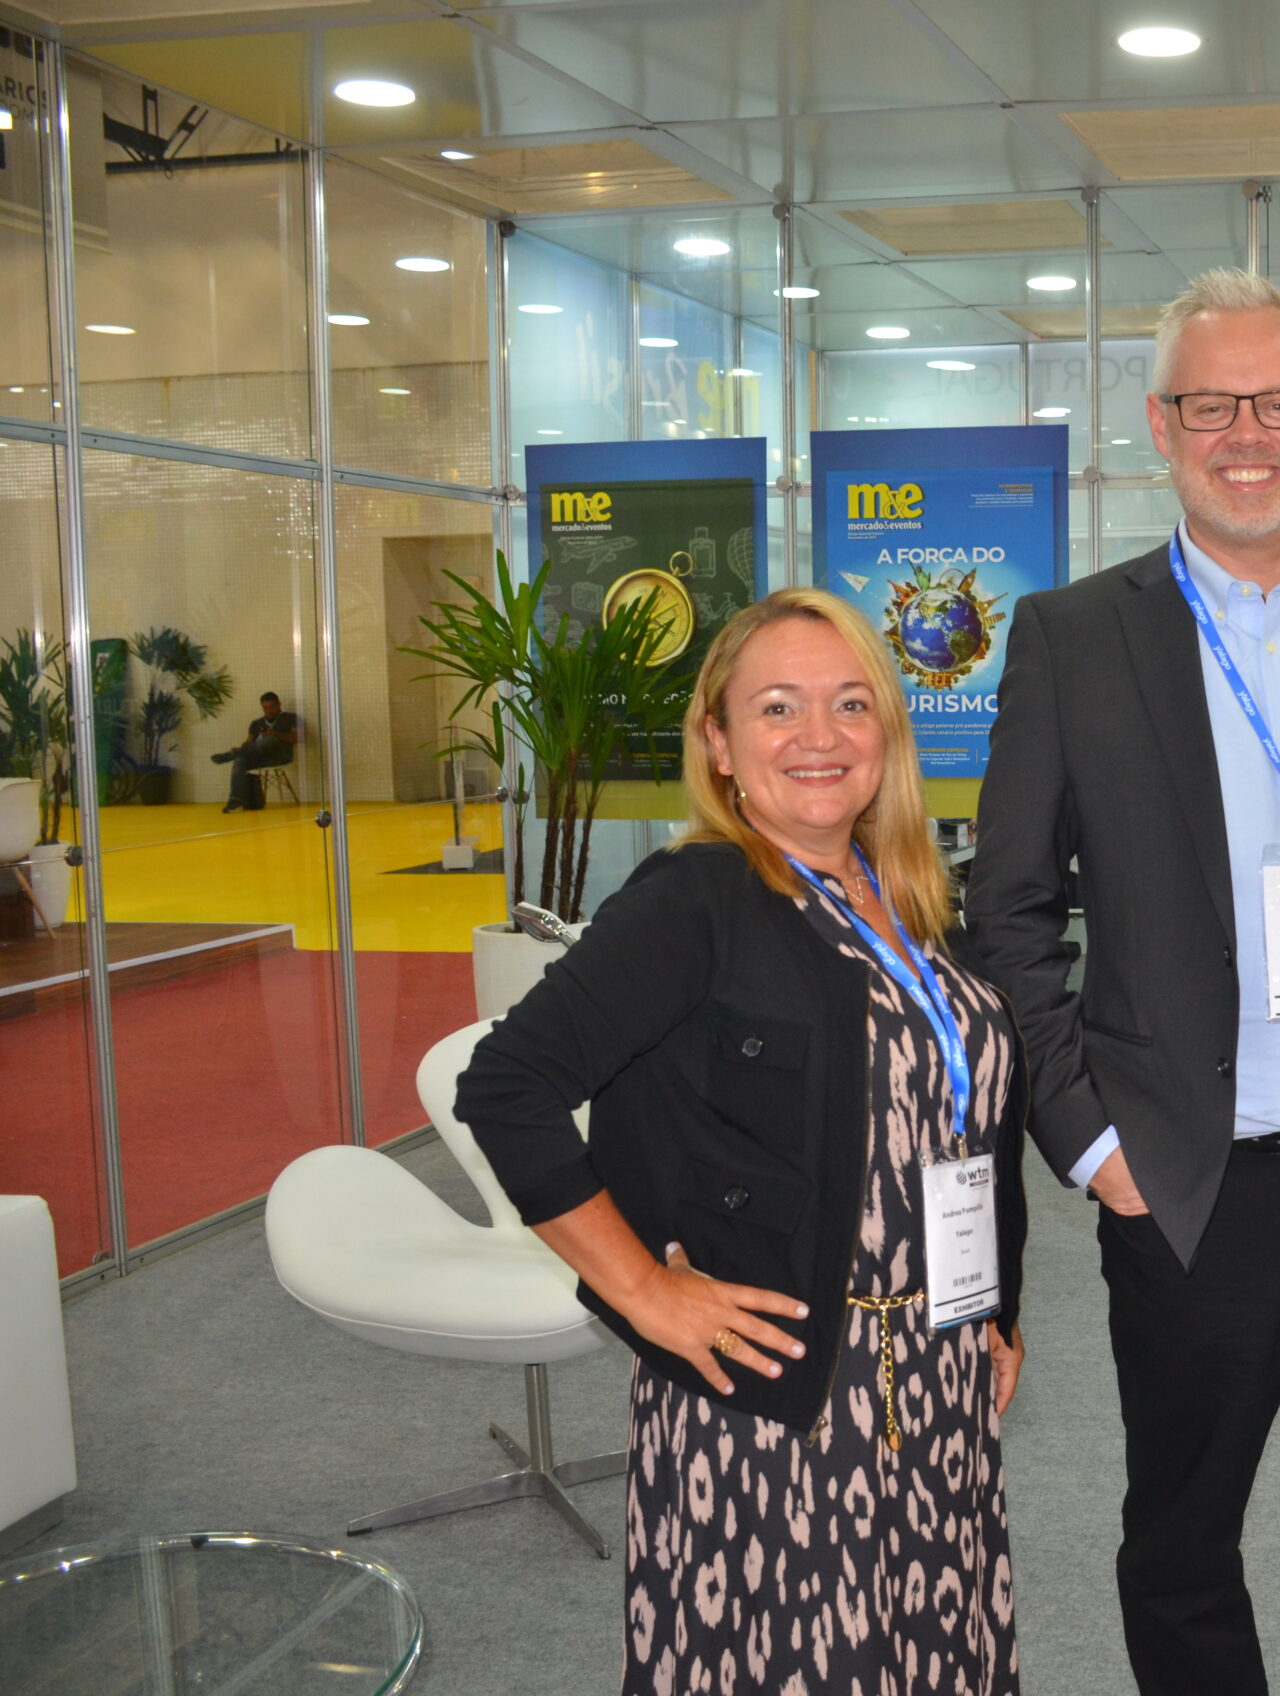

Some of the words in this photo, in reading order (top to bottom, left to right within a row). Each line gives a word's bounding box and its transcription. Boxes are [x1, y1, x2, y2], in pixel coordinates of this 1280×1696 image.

[550, 491, 613, 523] m&e
[847, 483, 925, 520] m&e
[551, 523, 613, 532] mercado&eventos
[847, 521, 922, 531] mercado&eventos
[876, 548, 893, 565] A
[896, 547, 969, 567] FORÇA
[972, 547, 1006, 564] DO
[905, 694, 999, 713] URISMO
[872, 940, 896, 967] yalago
[968, 1167, 989, 1181] wtm
[954, 1299, 984, 1314] EXHIBITOR
